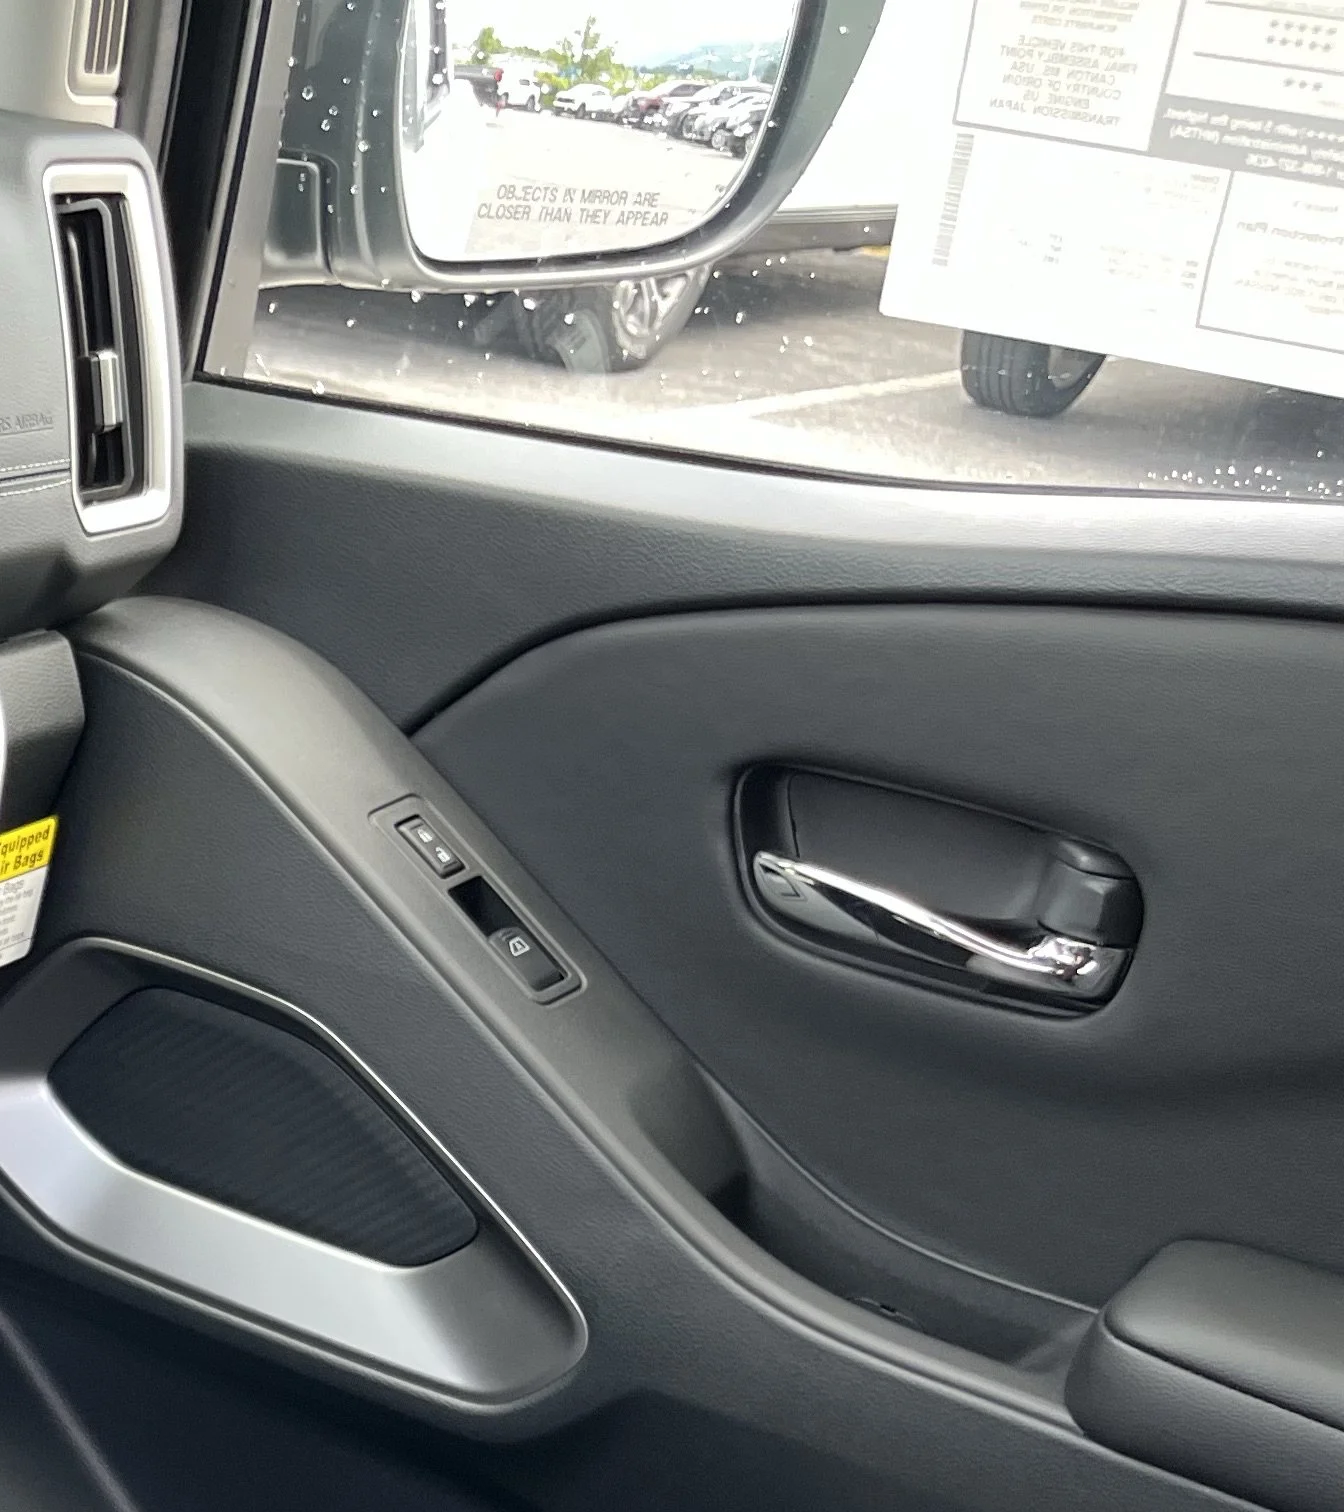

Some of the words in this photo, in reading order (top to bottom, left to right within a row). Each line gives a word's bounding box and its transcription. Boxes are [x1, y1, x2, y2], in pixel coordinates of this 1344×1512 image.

[580, 189, 629, 206] MIRROR
[633, 192, 661, 208] ARE
[477, 203, 532, 221] CLOSER
[538, 206, 572, 223] THAN
[579, 208, 611, 224] THEY
[615, 210, 668, 227] APPEAR
[13, 849, 44, 870] Bags
